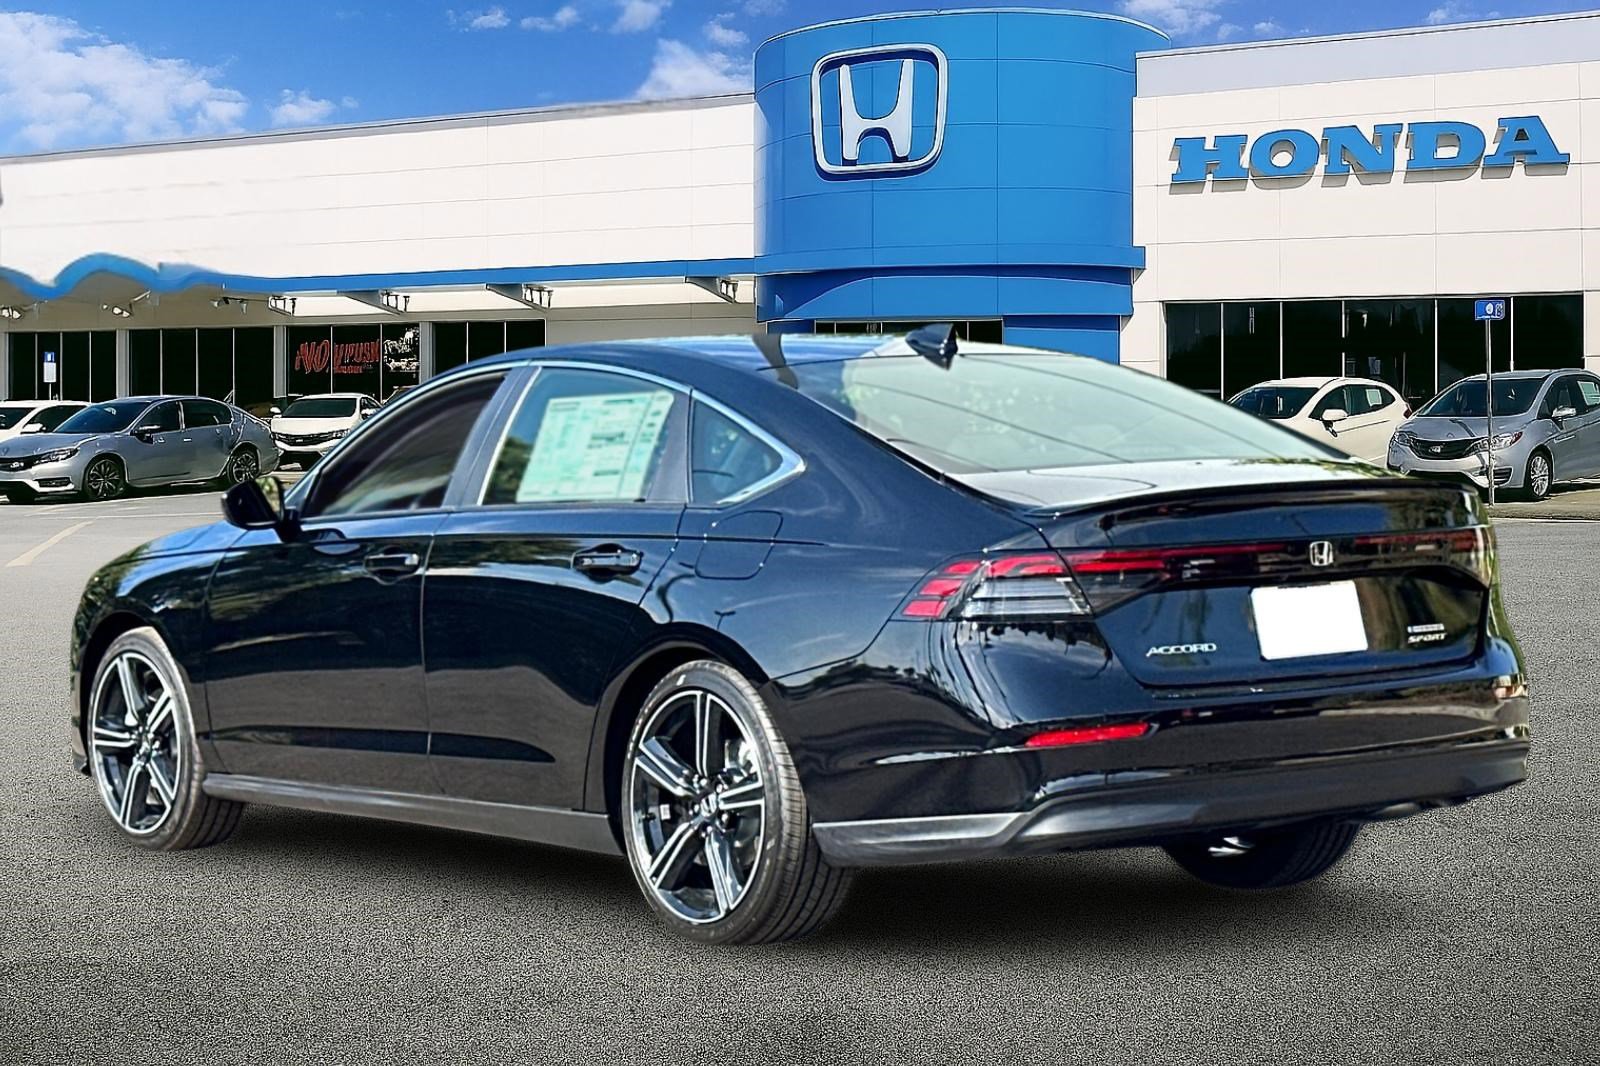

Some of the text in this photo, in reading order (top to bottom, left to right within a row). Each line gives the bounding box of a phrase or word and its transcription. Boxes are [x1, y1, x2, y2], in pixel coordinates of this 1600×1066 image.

[1171, 115, 1570, 183] HONDA
[1407, 632, 1447, 644] SPORT
[1146, 643, 1217, 658] ACCORD
